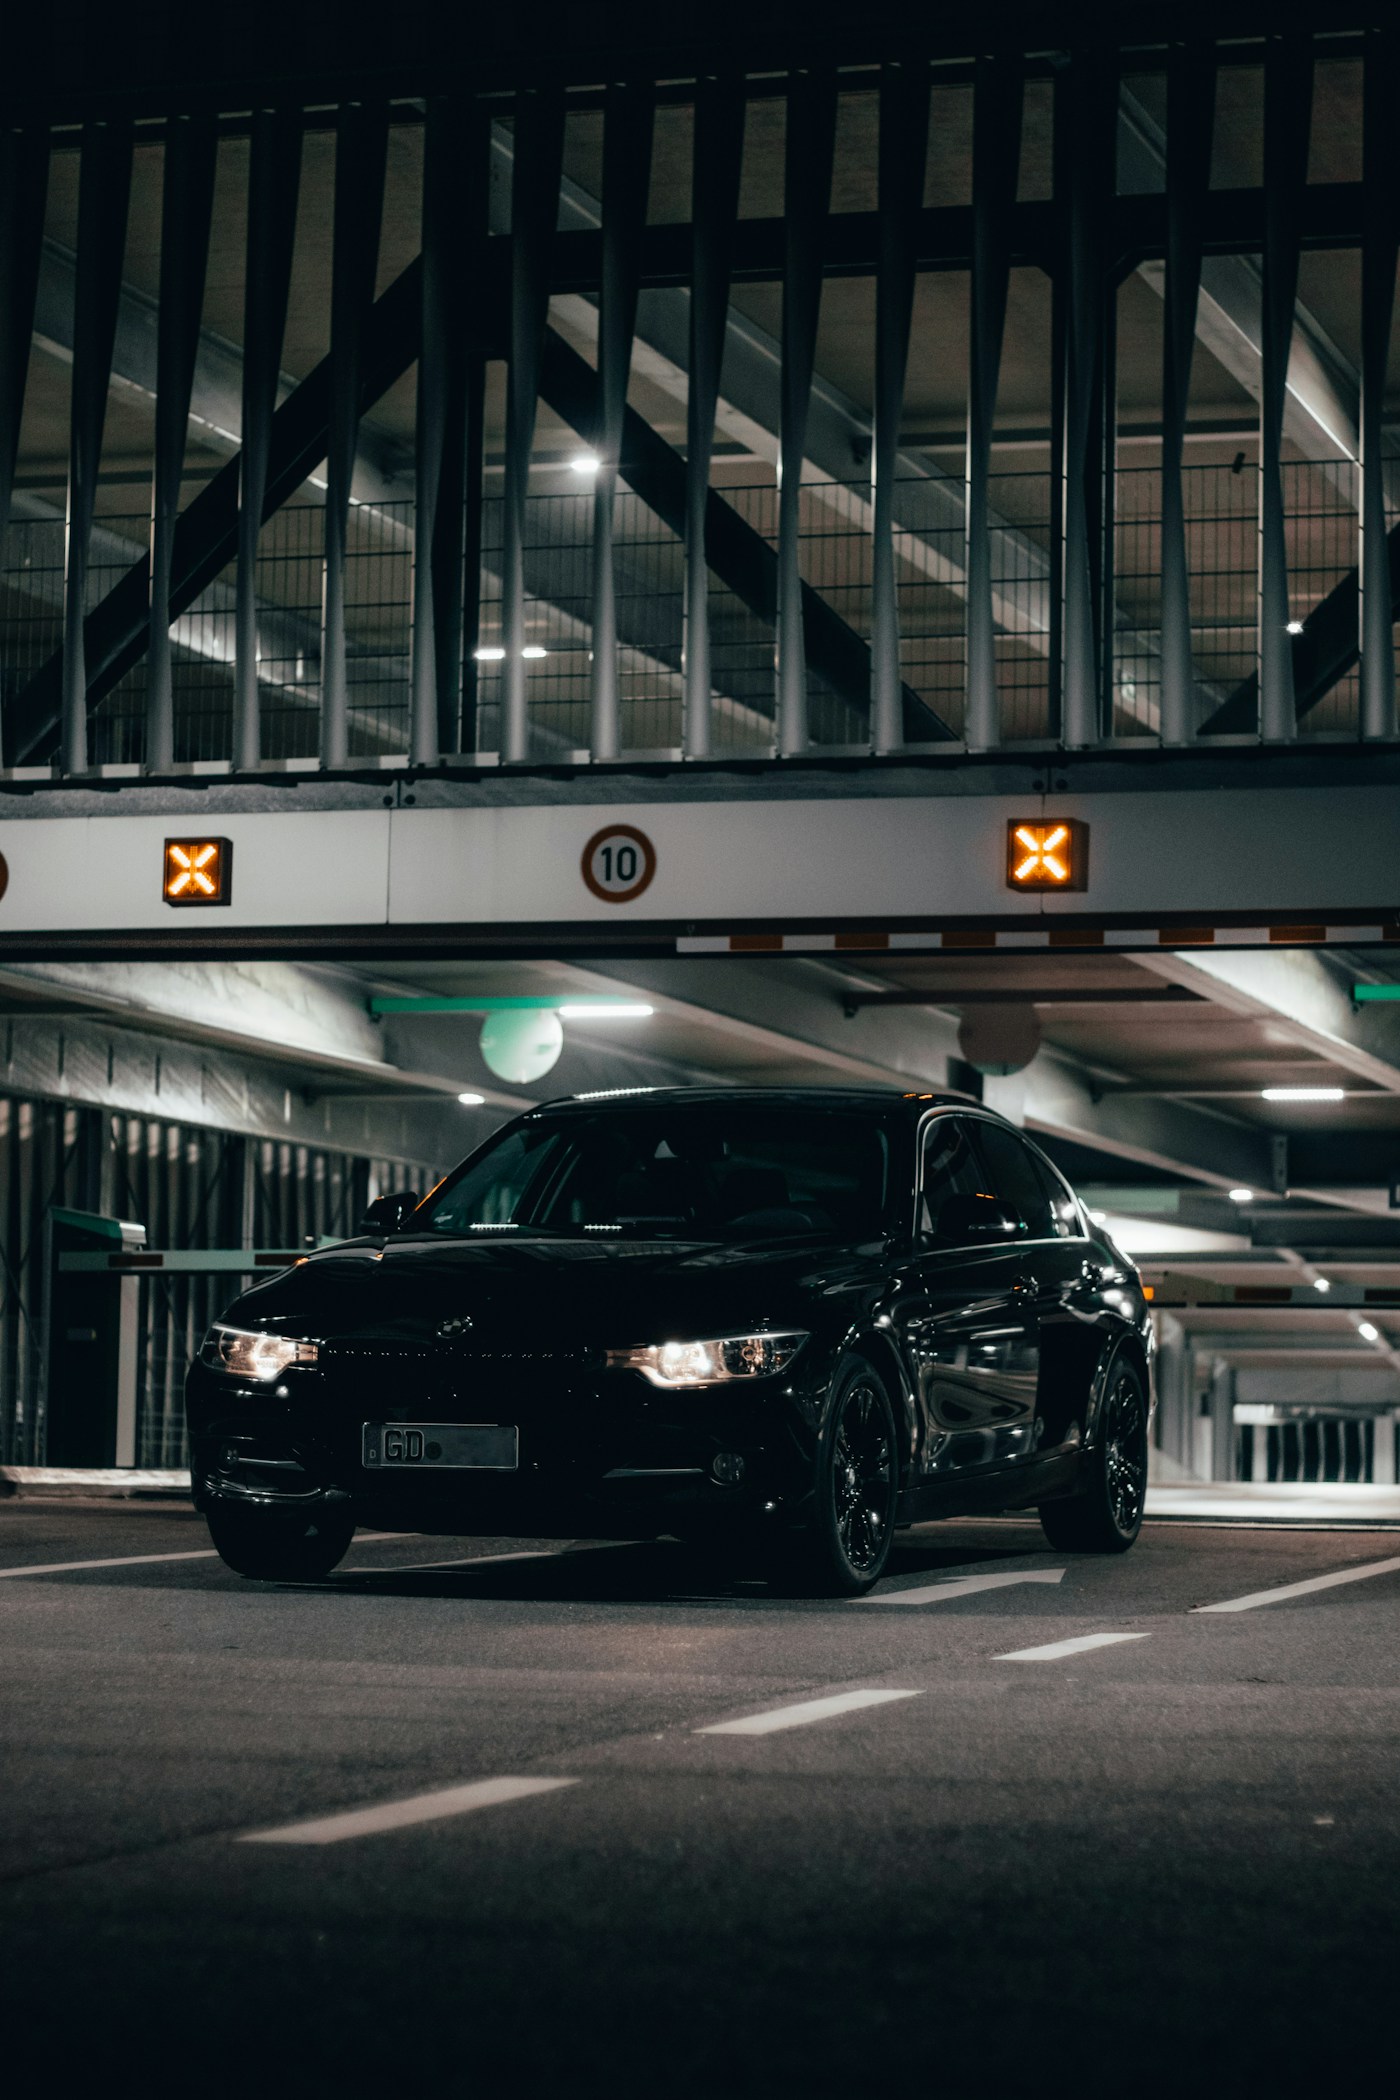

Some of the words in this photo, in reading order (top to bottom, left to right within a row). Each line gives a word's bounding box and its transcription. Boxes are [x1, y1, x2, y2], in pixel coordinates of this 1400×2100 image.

[601, 846, 636, 881] 10
[369, 1449, 377, 1459] D
[384, 1429, 425, 1461] GD
